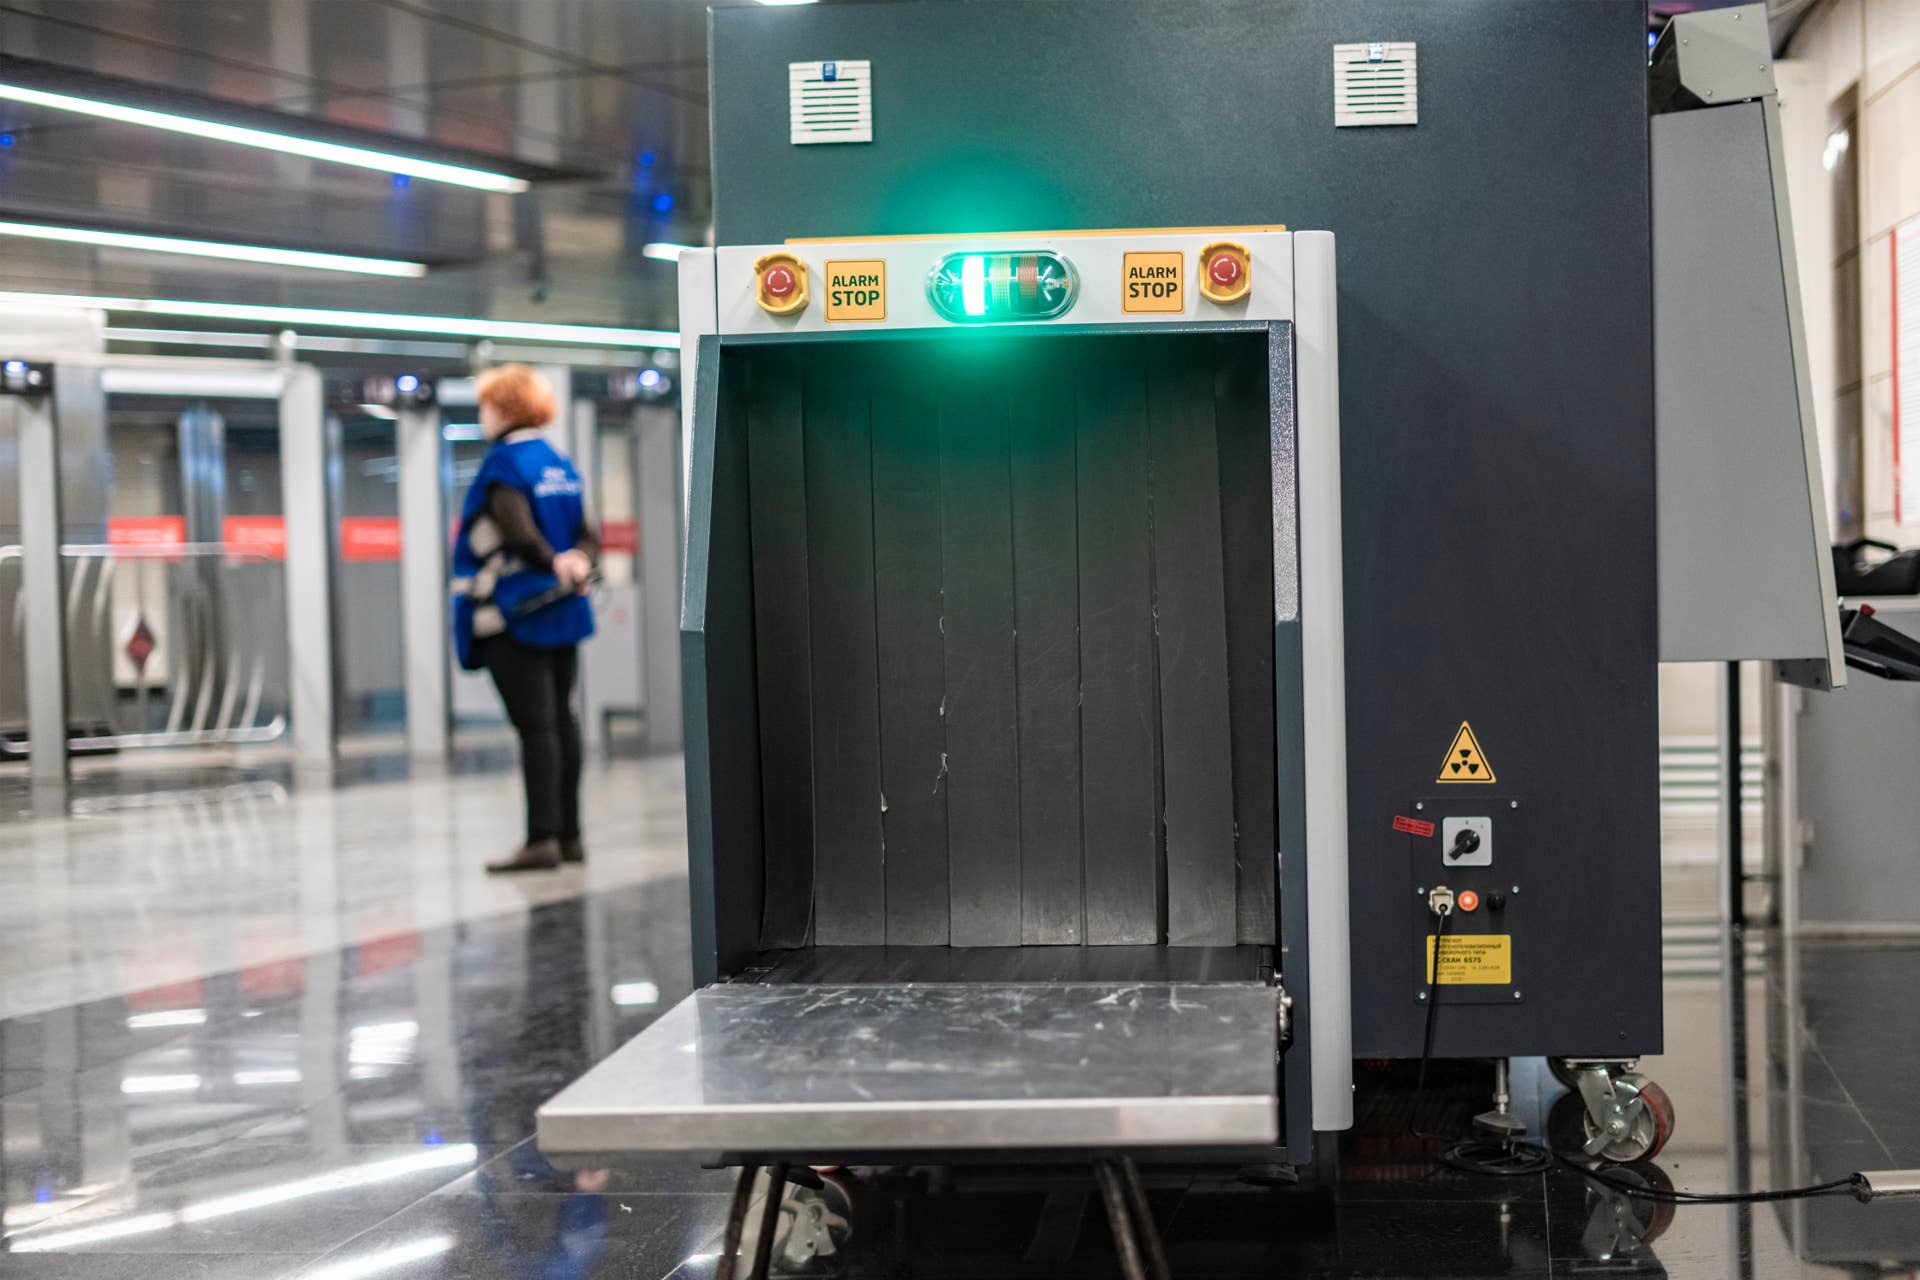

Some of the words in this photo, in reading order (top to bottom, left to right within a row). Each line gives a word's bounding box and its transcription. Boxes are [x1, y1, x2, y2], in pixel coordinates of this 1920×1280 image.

[1129, 267, 1176, 278] ALARM
[832, 275, 878, 287] ALARM
[1129, 282, 1177, 298] STOP
[832, 291, 880, 306] STOP
